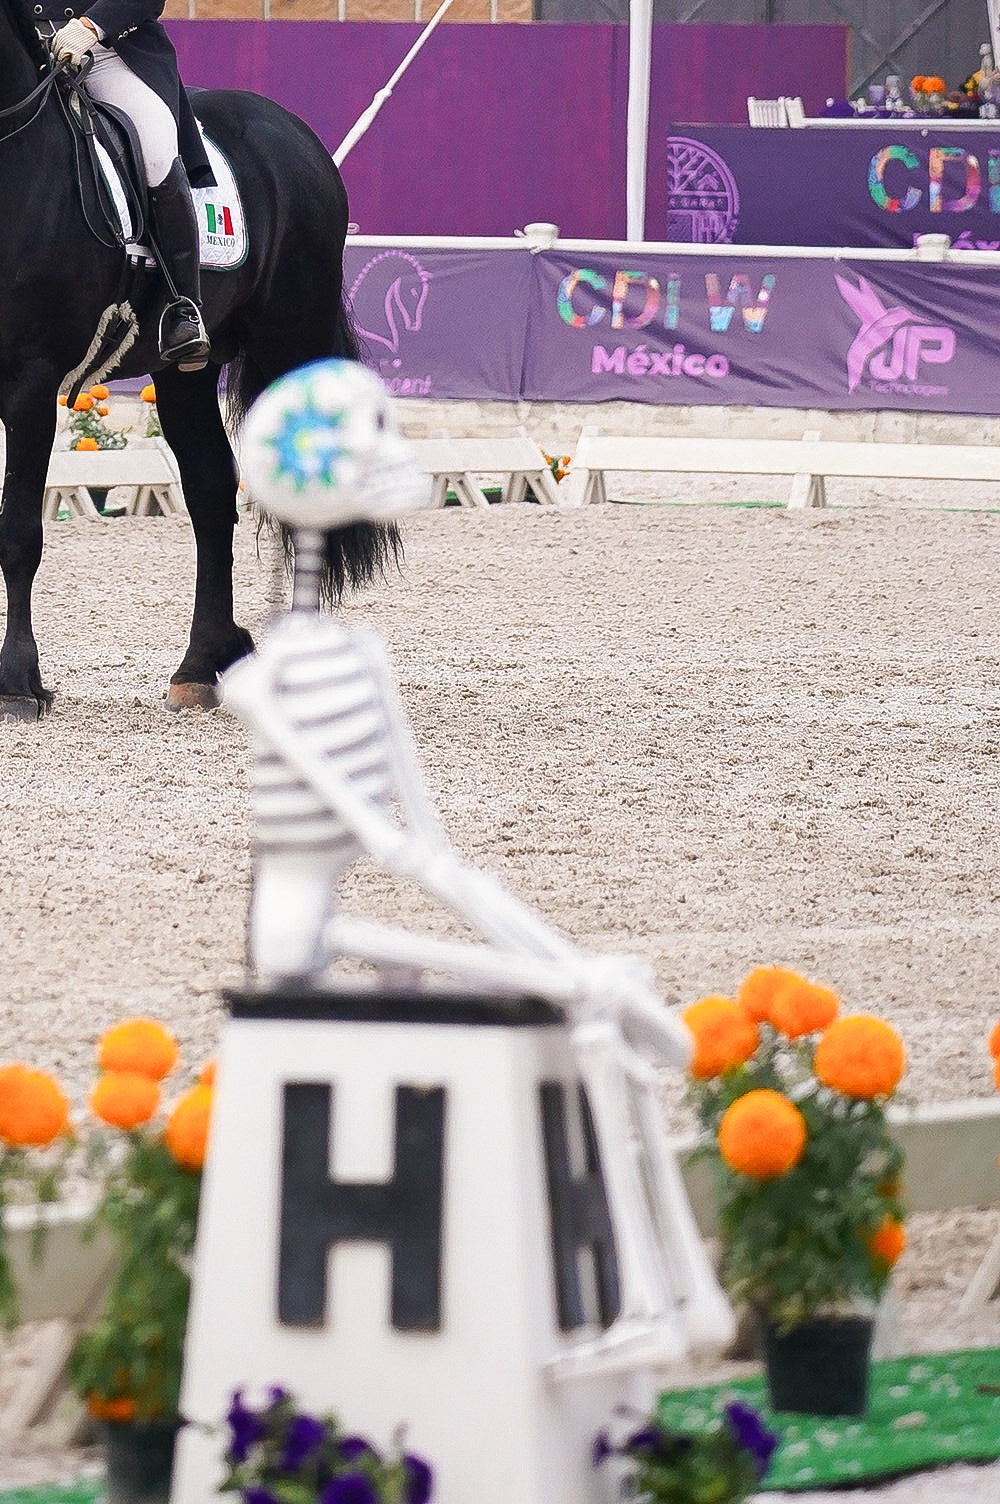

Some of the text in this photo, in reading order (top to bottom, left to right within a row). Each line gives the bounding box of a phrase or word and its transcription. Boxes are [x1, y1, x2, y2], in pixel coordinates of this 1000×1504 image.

[206, 235, 235, 248] MEXICO
[557, 268, 776, 333] CDI W
[591, 343, 729, 377] México
[277, 1079, 448, 1335] H
[537, 1079, 622, 1337] H
